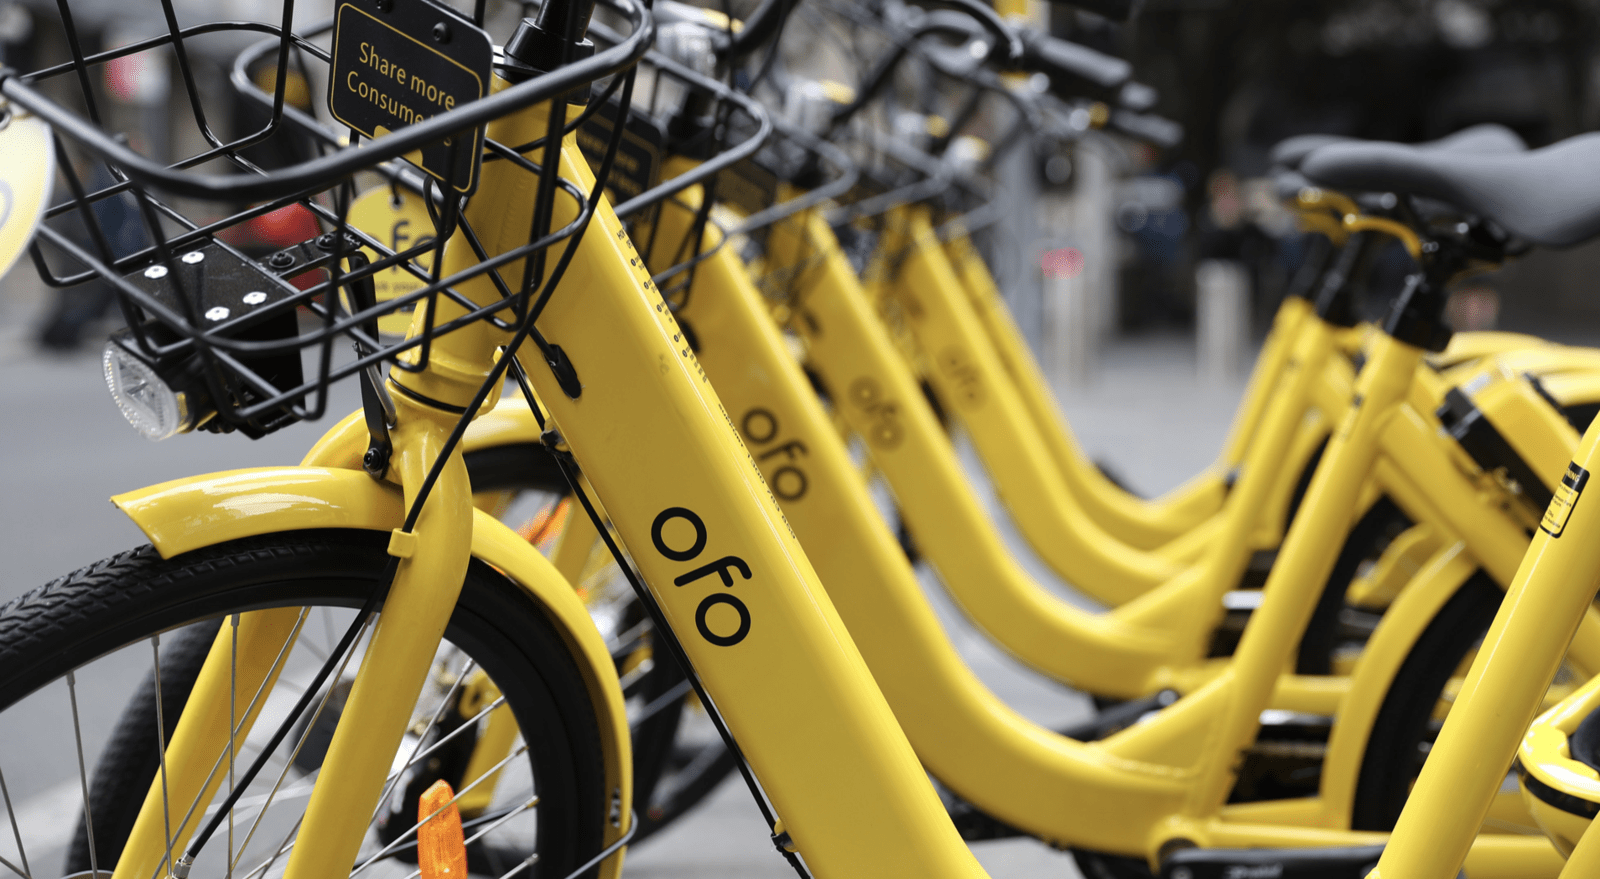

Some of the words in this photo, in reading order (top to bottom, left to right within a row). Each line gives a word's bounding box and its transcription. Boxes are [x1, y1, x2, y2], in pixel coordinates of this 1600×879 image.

[347, 71, 424, 125] Consume
[359, 42, 406, 85] Share
[411, 75, 455, 111] more
[848, 377, 904, 452] ofo
[742, 407, 808, 503] ofo
[651, 507, 752, 647] ofo
